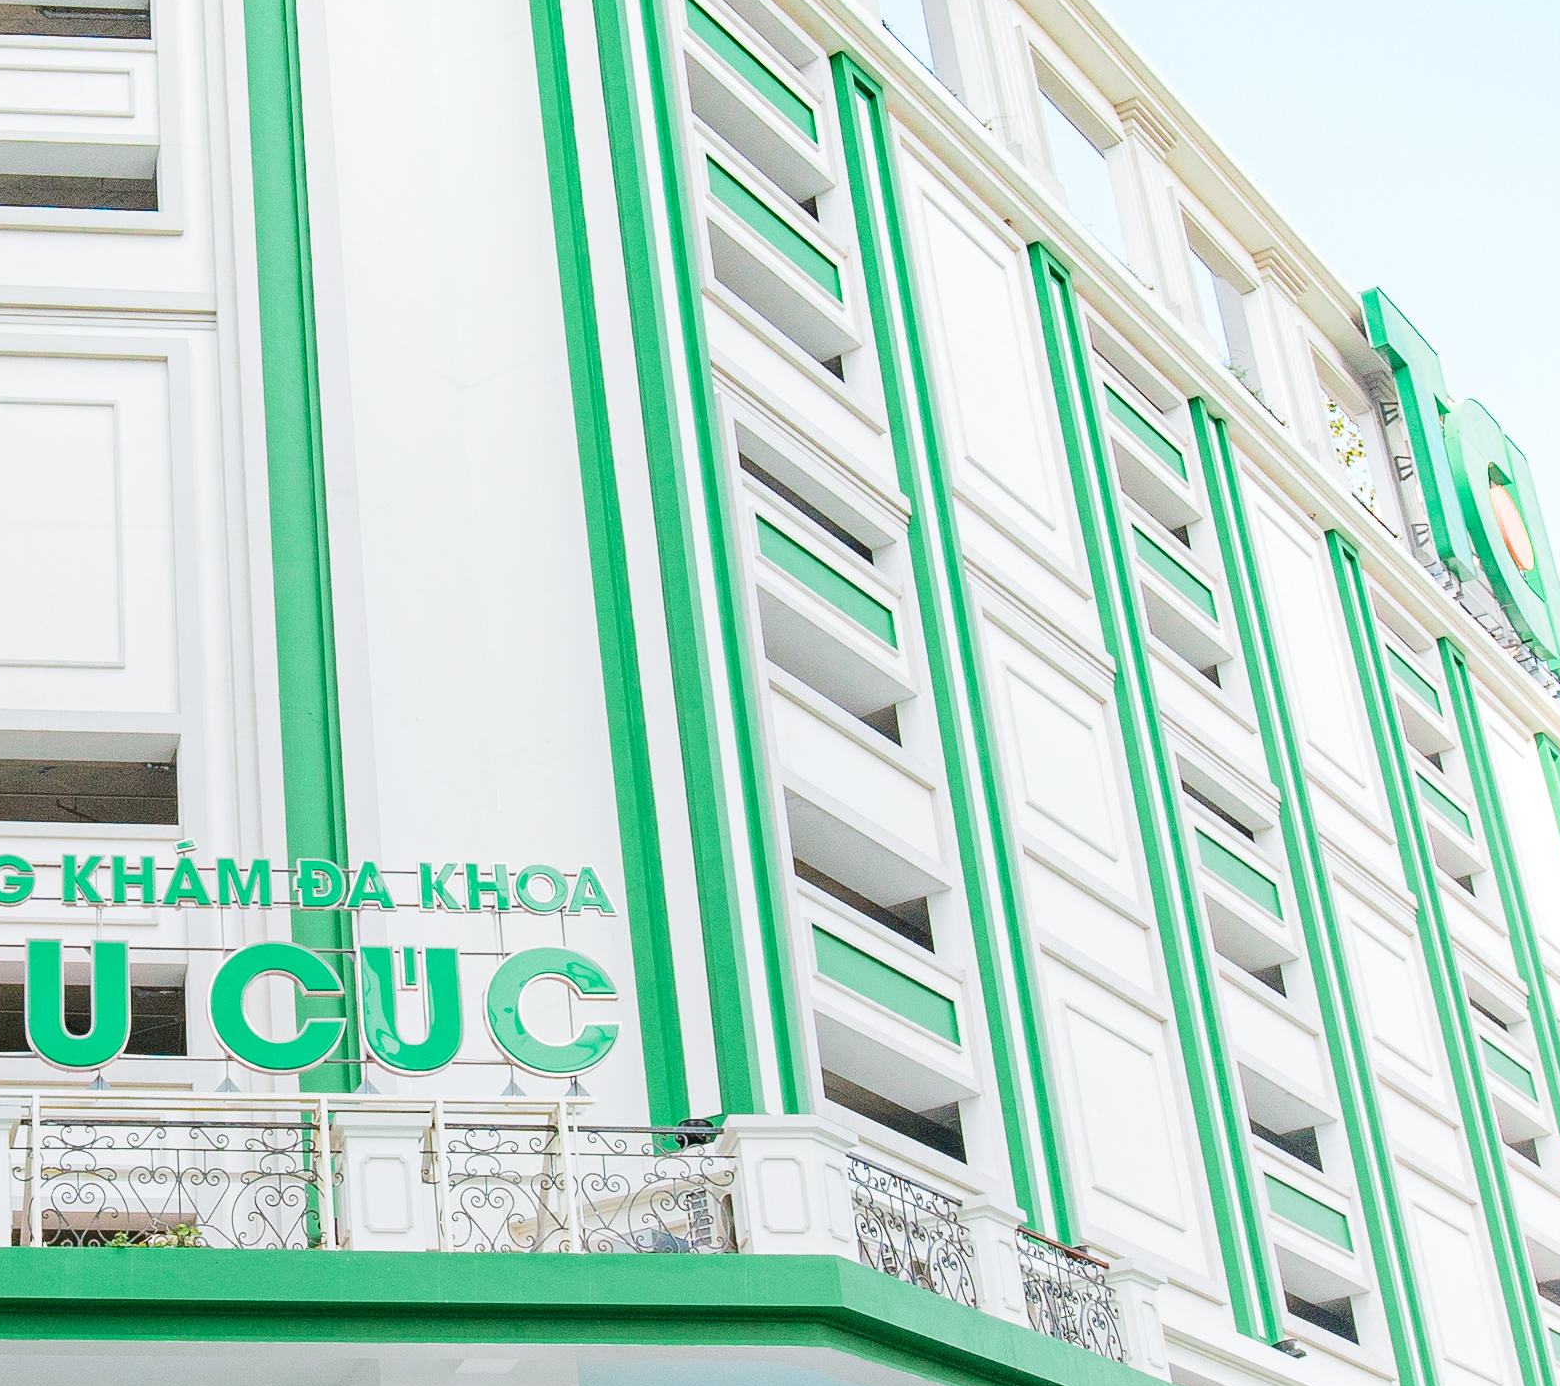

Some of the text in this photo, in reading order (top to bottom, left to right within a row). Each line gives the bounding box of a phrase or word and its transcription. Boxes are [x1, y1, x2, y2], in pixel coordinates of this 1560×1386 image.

[62, 838, 272, 910] KHÁM
[293, 858, 397, 912] ĐA
[417, 861, 619, 917] KHOA
[207, 941, 622, 1078] CÚC
